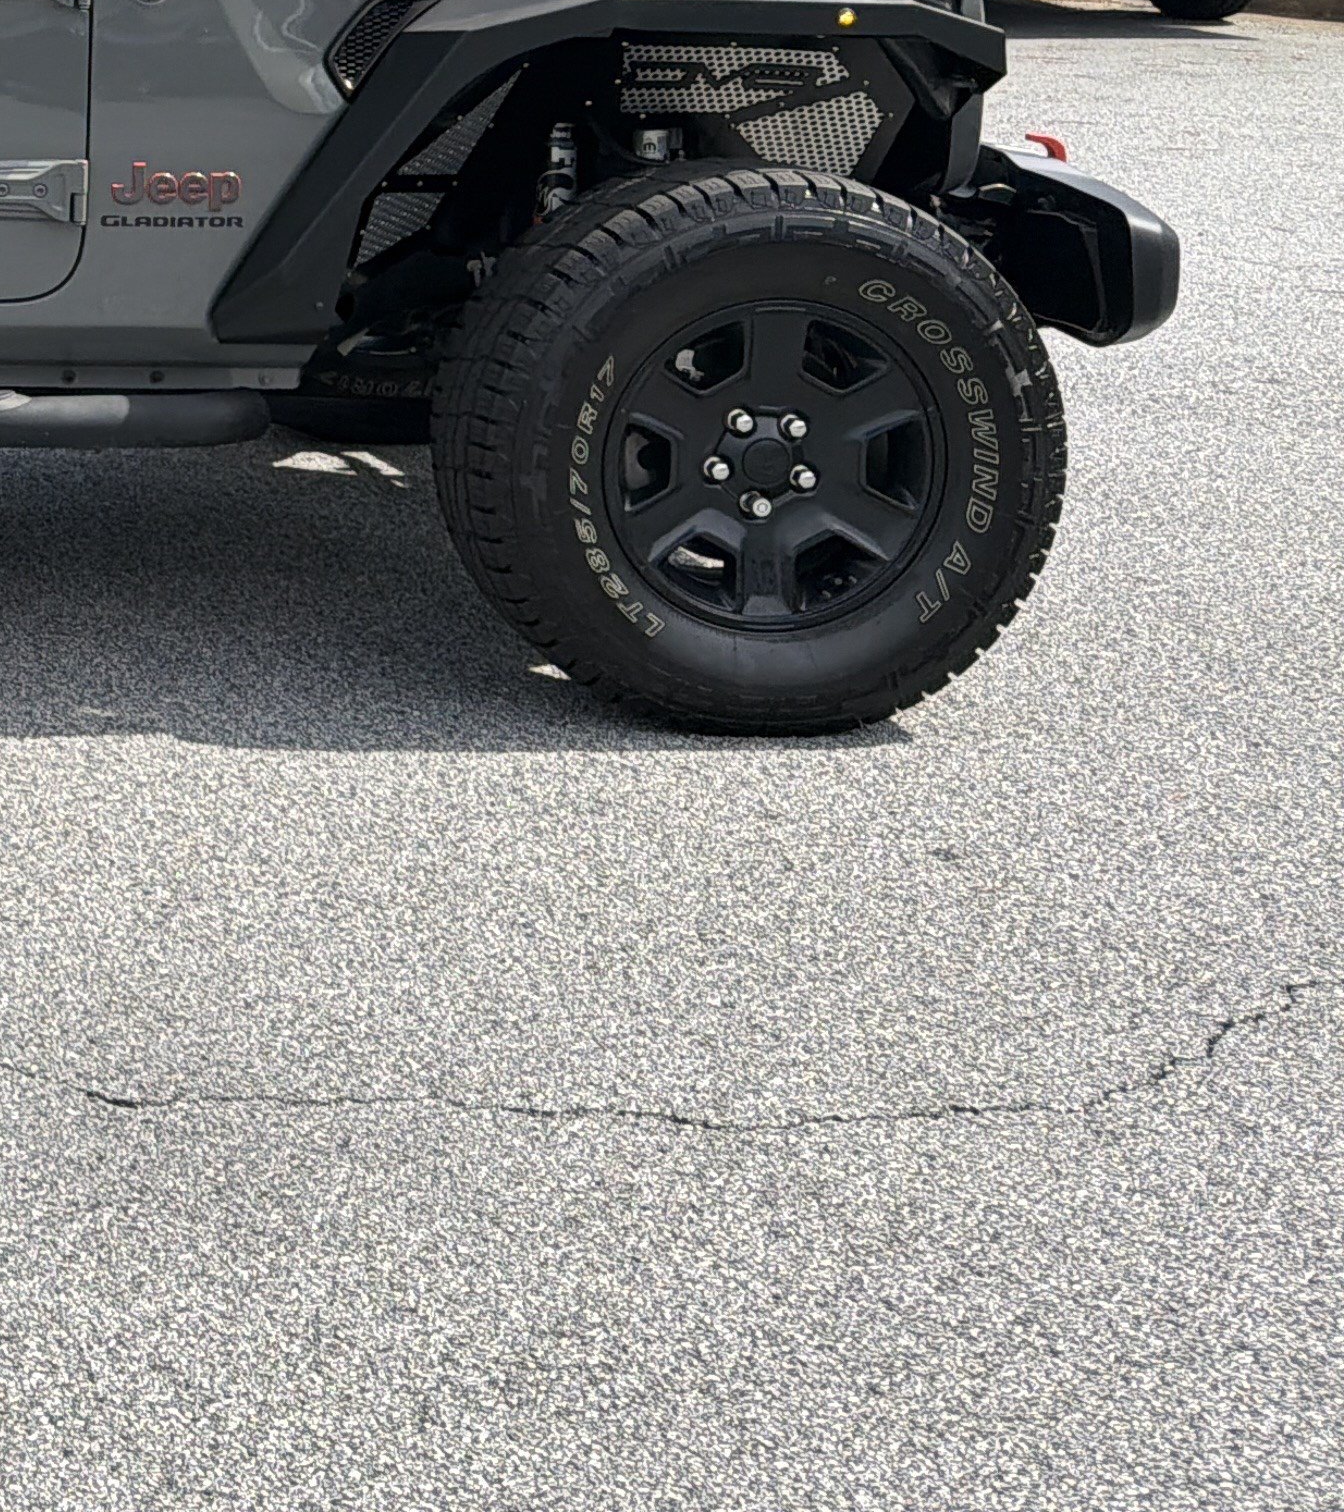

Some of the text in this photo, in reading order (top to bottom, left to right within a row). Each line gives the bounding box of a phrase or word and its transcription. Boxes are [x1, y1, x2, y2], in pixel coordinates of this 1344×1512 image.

[100, 214, 244, 229] GLADIATOR
[111, 161, 243, 213] Jeep
[568, 355, 667, 638] LT285/70R17
[858, 279, 1001, 625] CROSSWIND A/T
